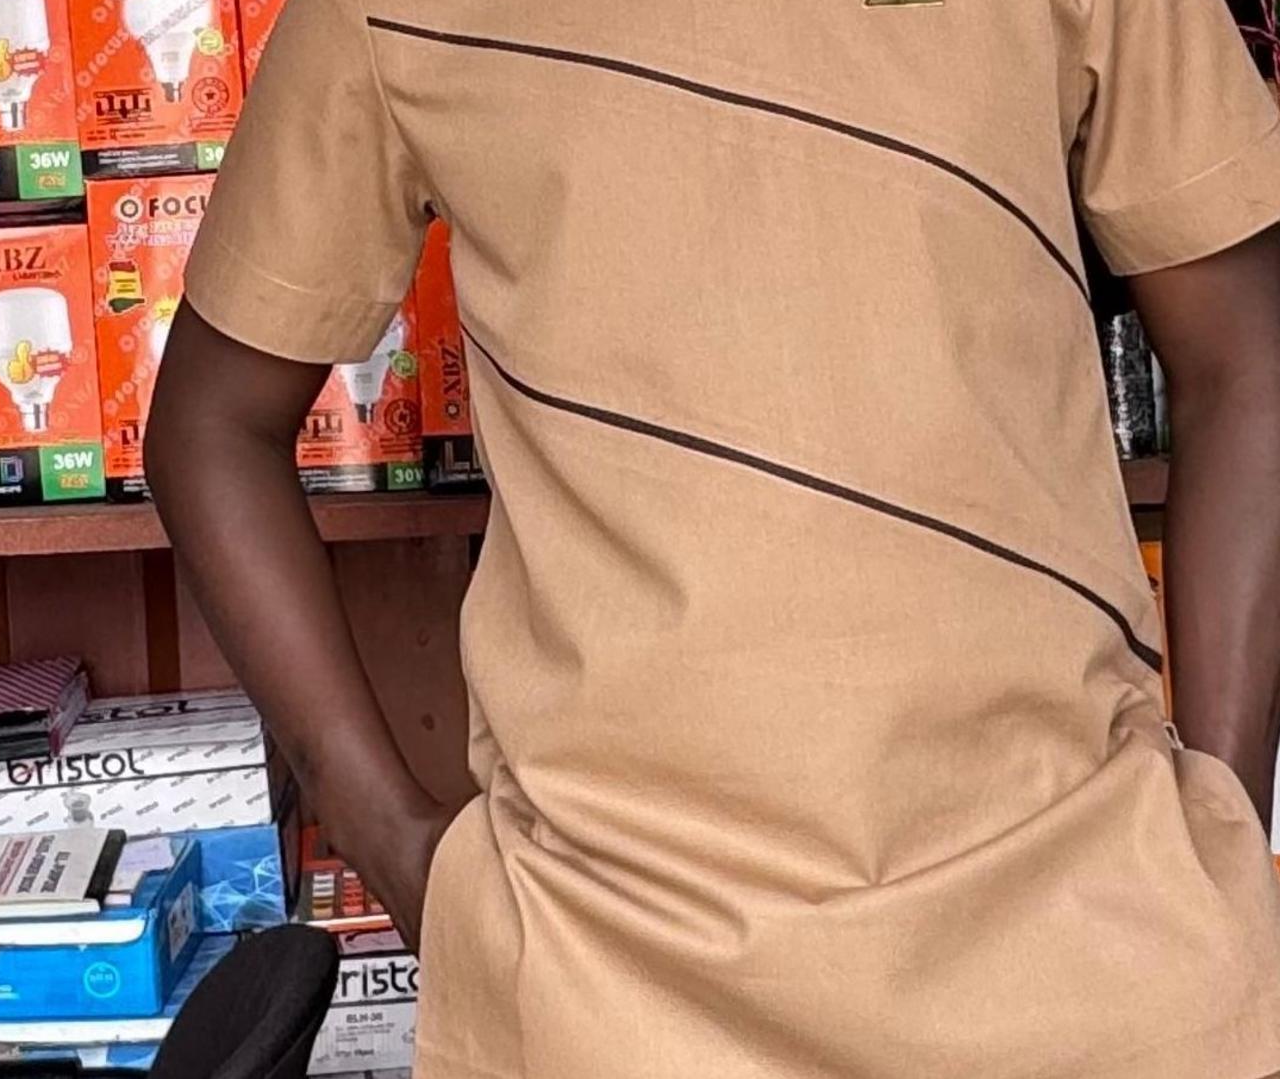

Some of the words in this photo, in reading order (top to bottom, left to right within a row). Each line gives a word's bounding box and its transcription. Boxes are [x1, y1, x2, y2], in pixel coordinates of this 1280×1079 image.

[29, 151, 70, 170] 36W
[204, 147, 224, 164] 30
[441, 342, 461, 396] XBZ
[52, 452, 93, 470] 36W
